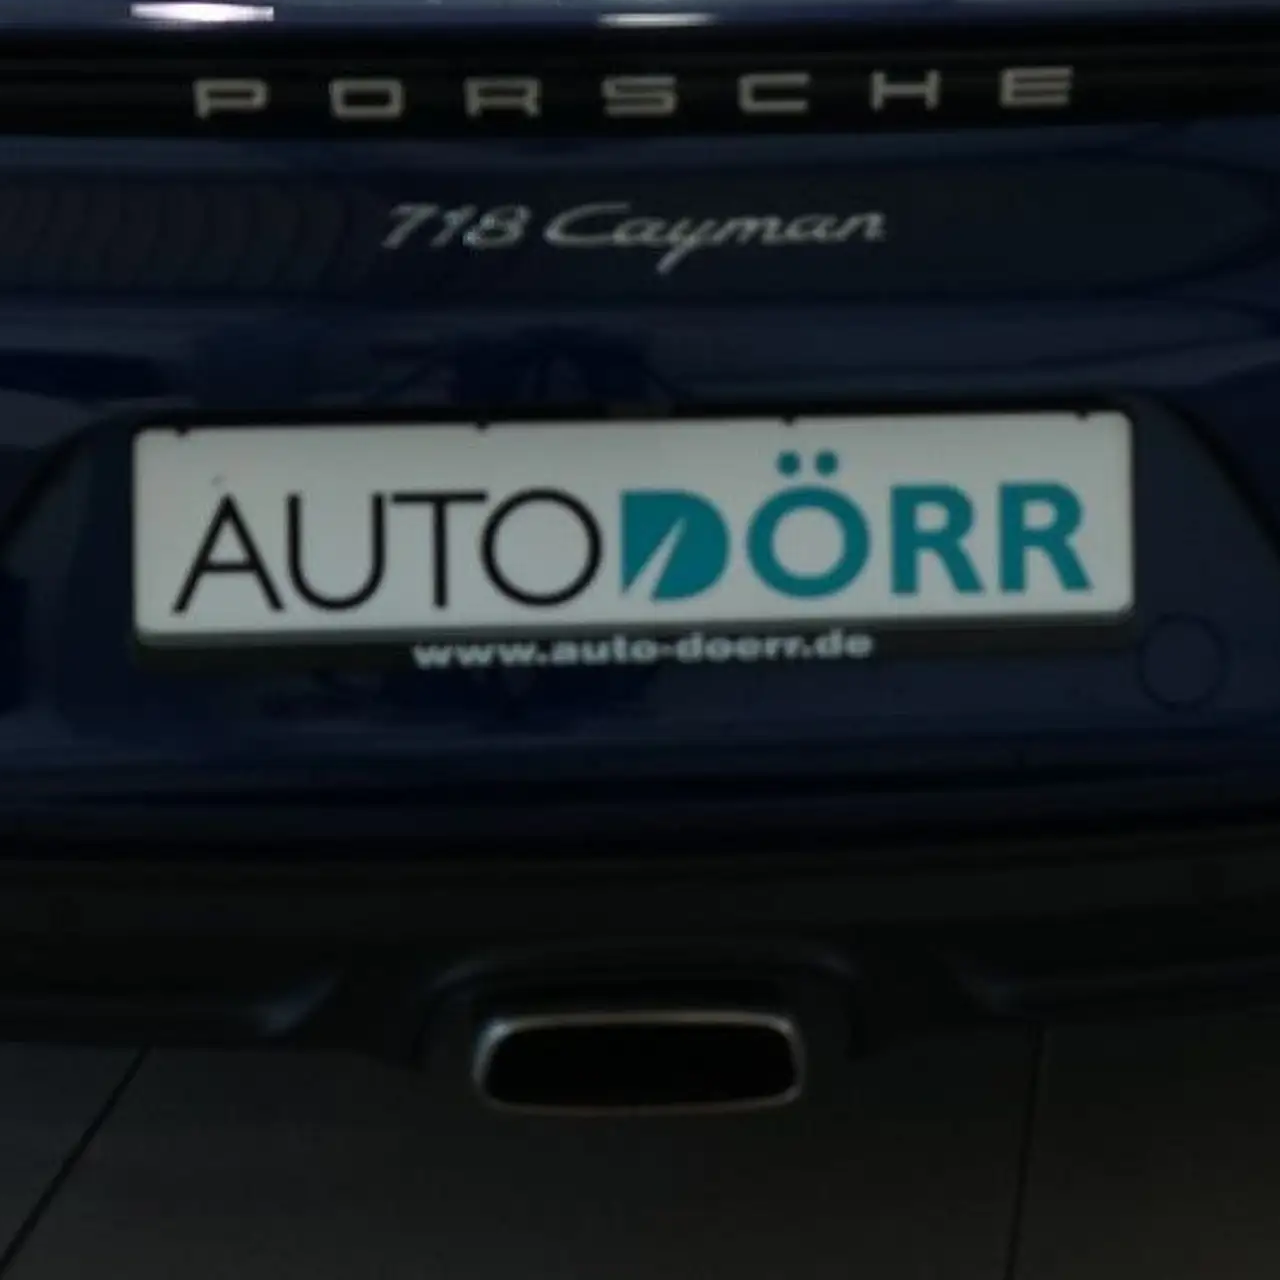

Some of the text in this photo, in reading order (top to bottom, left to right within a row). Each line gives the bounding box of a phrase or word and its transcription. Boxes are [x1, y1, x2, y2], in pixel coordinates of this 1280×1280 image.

[194, 67, 1073, 118] PORSCHE
[382, 201, 885, 275] 718 Cayman
[412, 629, 875, 669] www.auto-doerr.de
